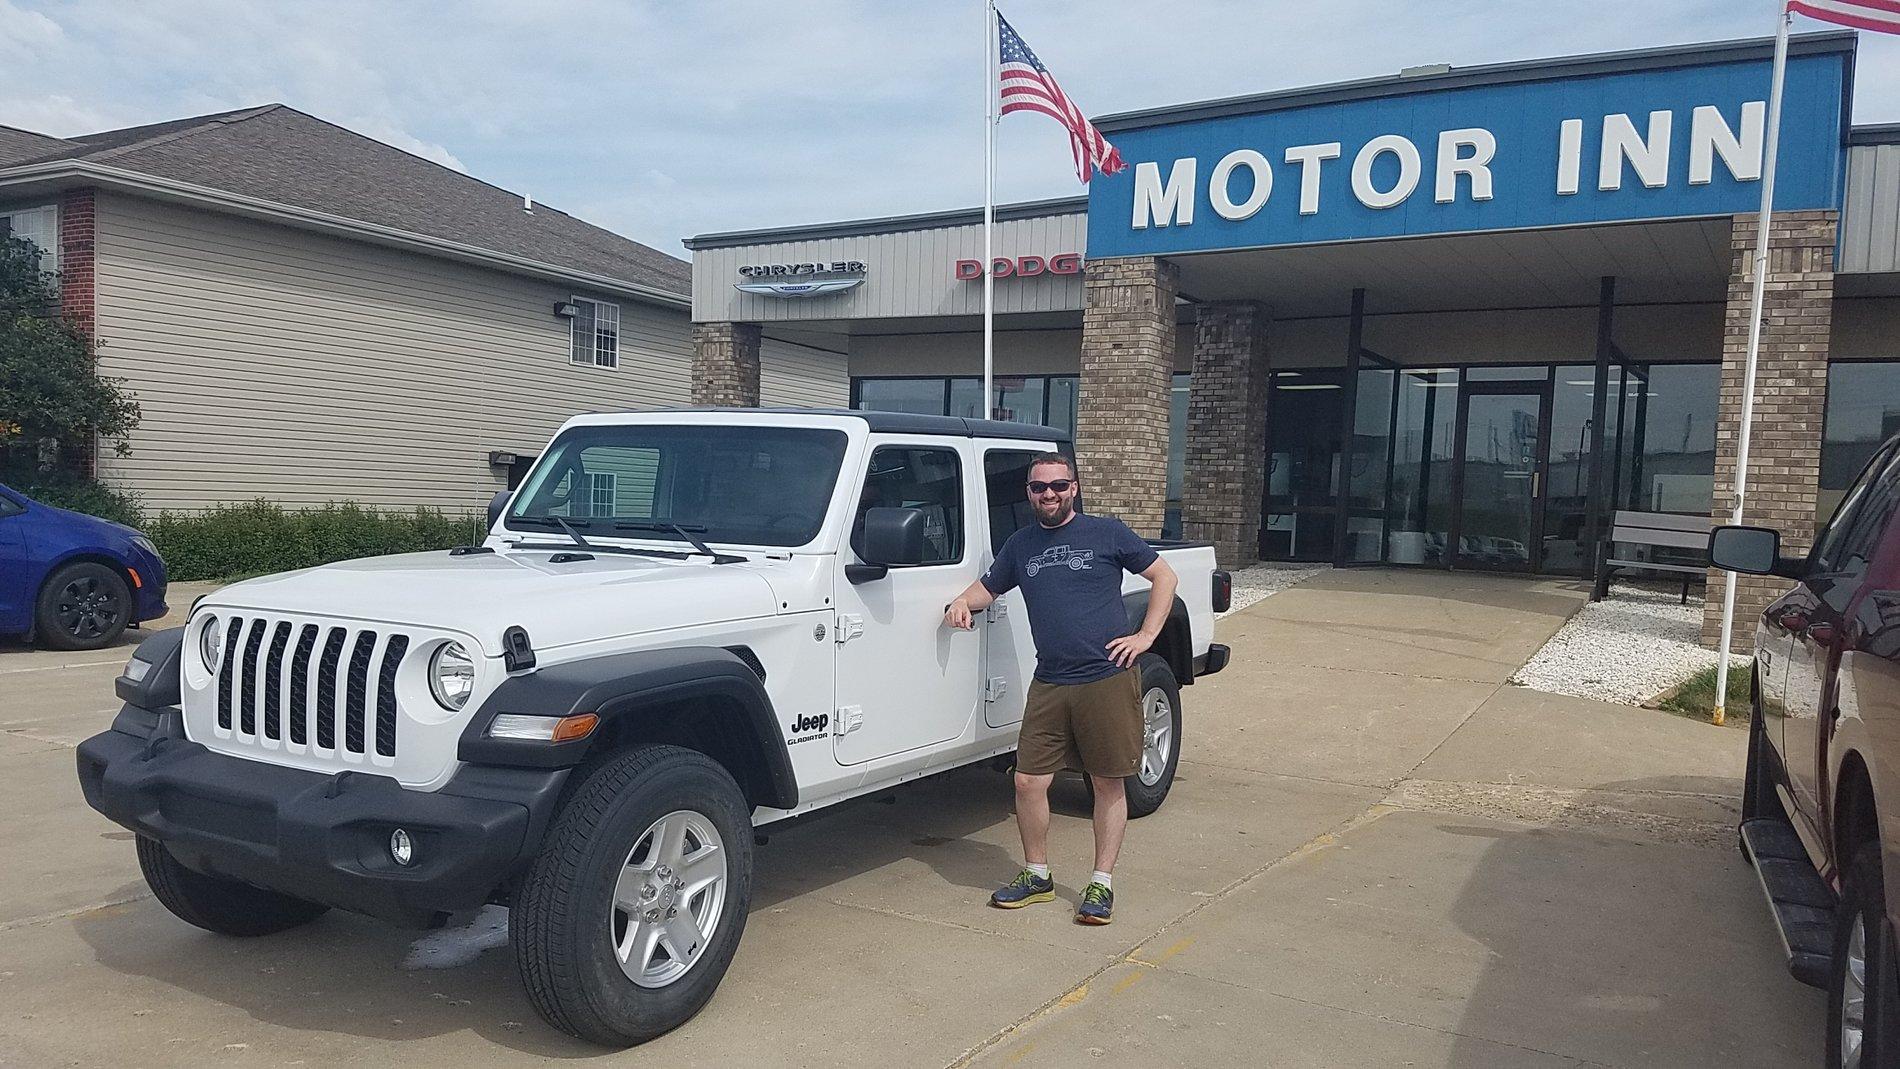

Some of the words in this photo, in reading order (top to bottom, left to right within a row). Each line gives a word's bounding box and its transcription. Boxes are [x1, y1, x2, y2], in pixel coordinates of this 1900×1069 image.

[1132, 128, 1496, 229] MOTOR
[1557, 101, 1766, 195] INN
[739, 260, 867, 277] CHRYSLER
[956, 252, 1087, 280] DODG
[791, 713, 828, 733] Jeep
[787, 732, 828, 745] GLADIATOR
